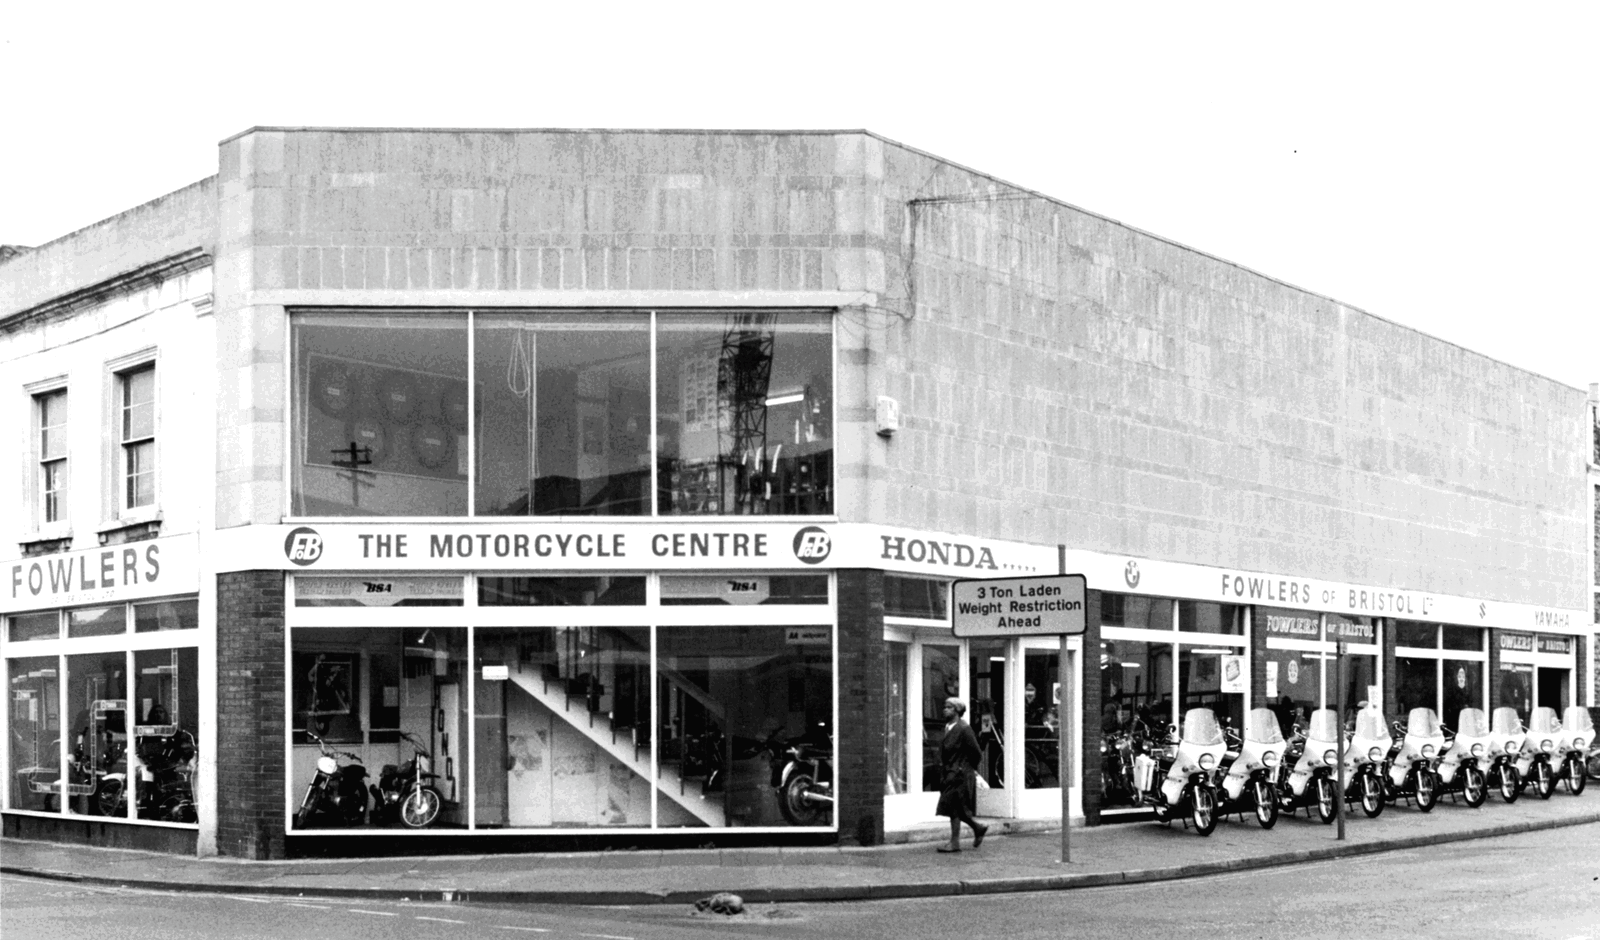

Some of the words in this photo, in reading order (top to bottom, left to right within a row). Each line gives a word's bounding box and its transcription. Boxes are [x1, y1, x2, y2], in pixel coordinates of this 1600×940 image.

[358, 534, 408, 558] THE
[430, 534, 626, 558] MOTORCYCLE
[652, 533, 767, 557] CENTRE
[12, 544, 160, 599] FOWLERS
[362, 581, 391, 593] BSA
[728, 580, 757, 592] BSA
[977, 586, 986, 600] 3
[990, 586, 1013, 599] Ton
[1020, 584, 1061, 598] Laden
[1222, 573, 1311, 604] FOWLERS
[1322, 590, 1336, 605] OF
[1349, 589, 1413, 614] BRISTOL
[958, 601, 1002, 616] Weight
[1009, 598, 1082, 613] Restriction
[997, 615, 1041, 628] Ahead
[1266, 615, 1319, 635] FOWLERS
[1339, 623, 1374, 638] BRISTOL
[1535, 610, 1570, 628] YAMAHA
